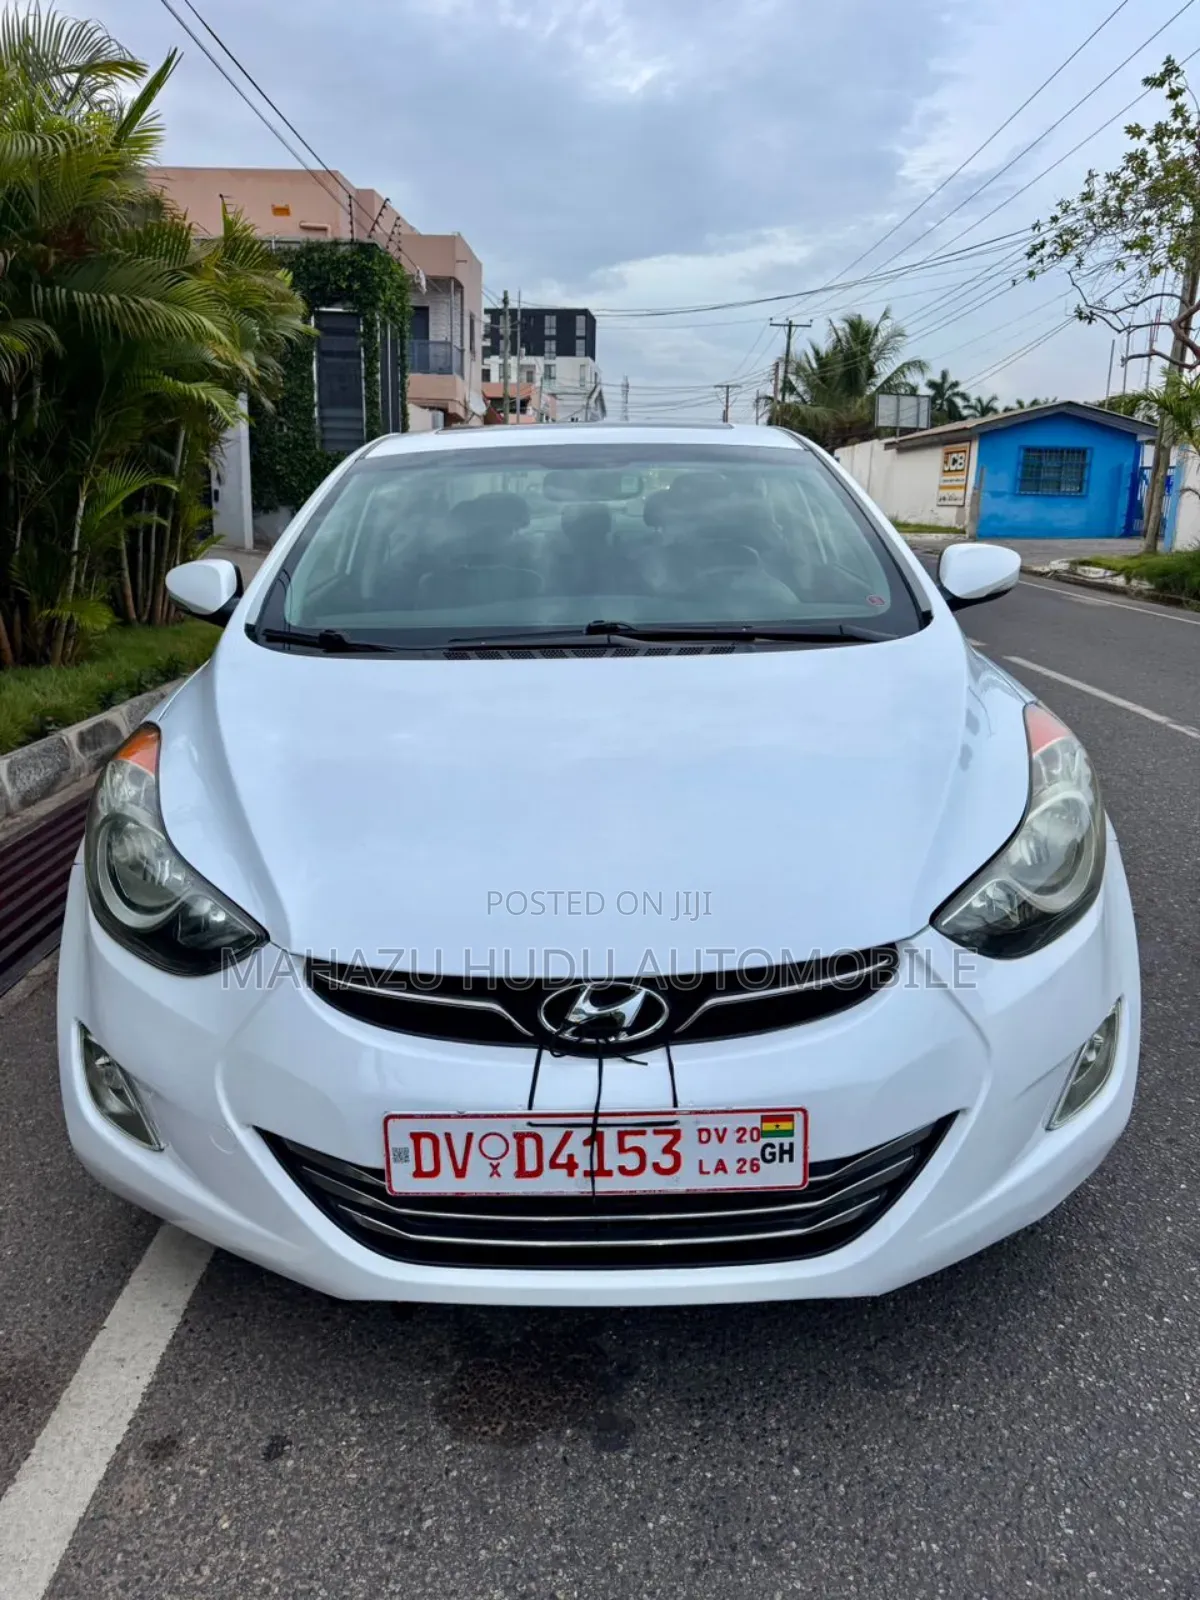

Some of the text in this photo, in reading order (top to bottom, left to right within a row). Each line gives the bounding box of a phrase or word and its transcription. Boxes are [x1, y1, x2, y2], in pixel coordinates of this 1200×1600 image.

[943, 452, 966, 471] JCB
[697, 1126, 761, 1145] DV 20
[409, 1131, 474, 1179] DV
[512, 1128, 682, 1179] D4153
[760, 1142, 795, 1164] GH
[698, 1157, 761, 1175] LA 26
